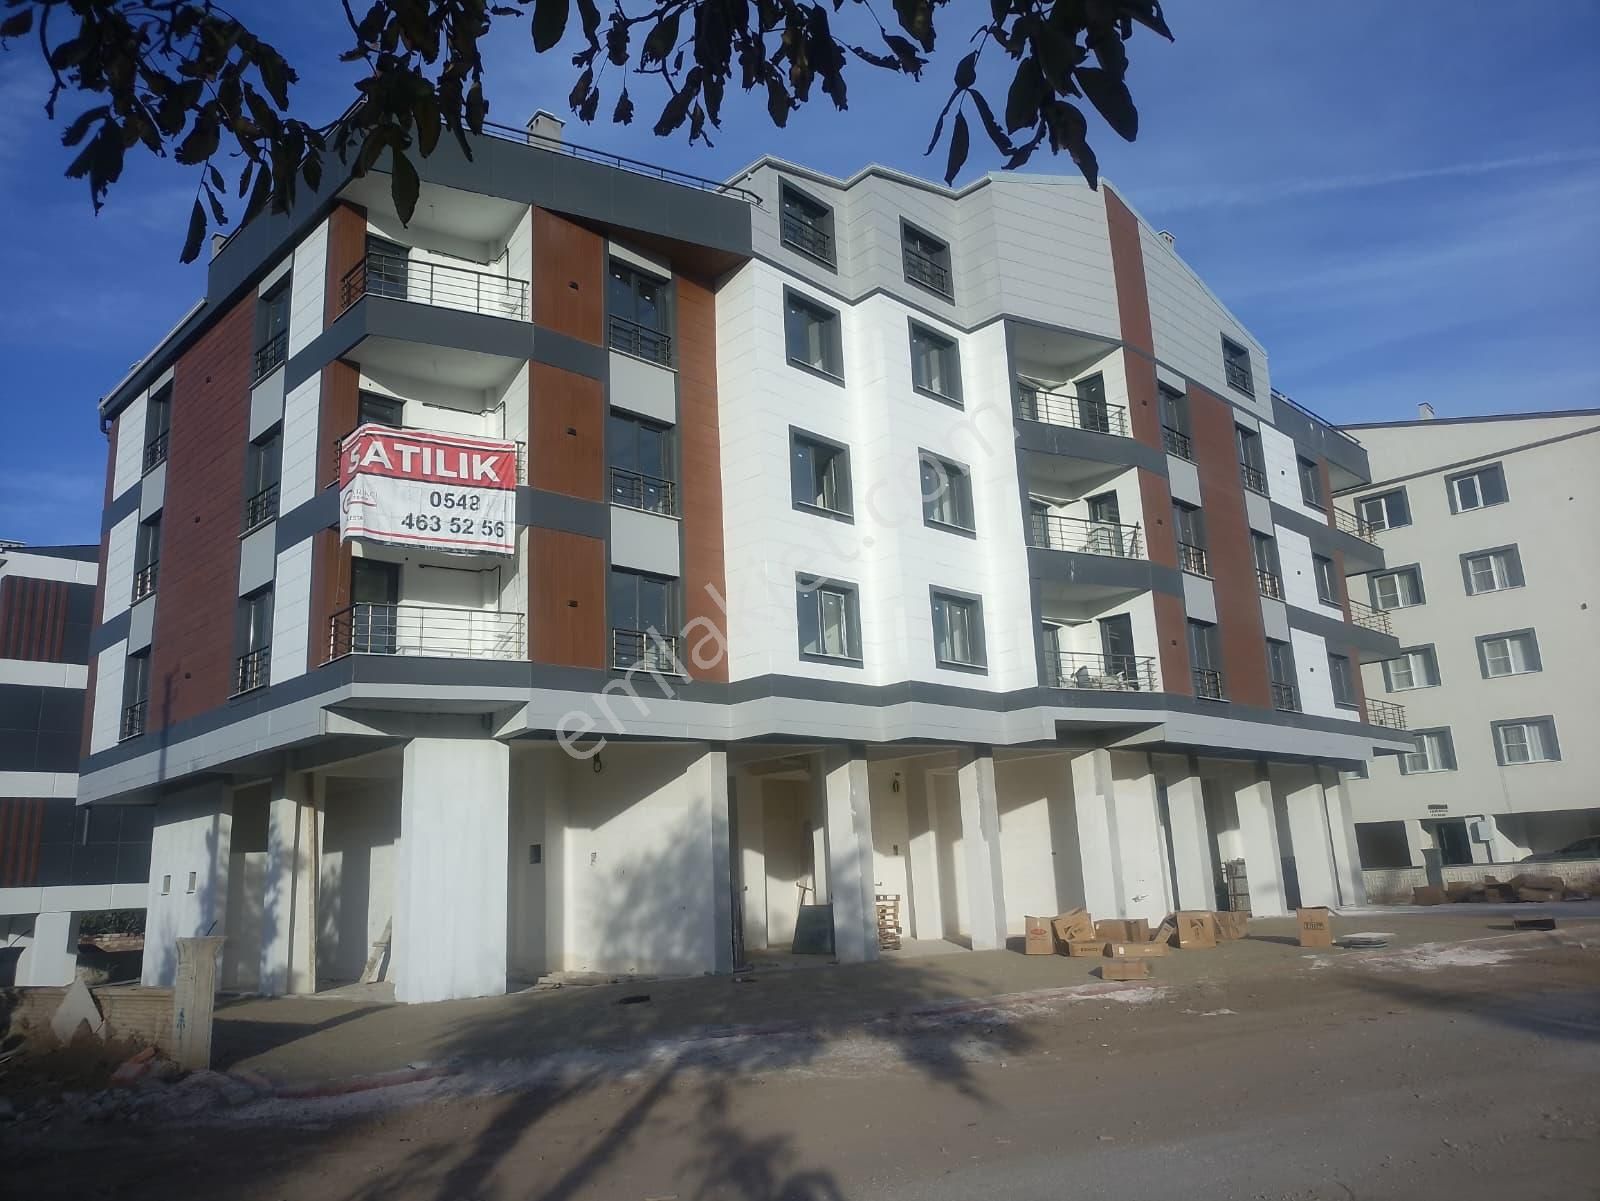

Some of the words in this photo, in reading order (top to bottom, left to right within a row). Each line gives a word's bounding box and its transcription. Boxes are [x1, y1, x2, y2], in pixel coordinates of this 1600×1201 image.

[347, 440, 501, 482] SATILIK
[401, 512, 442, 532] 463
[449, 517, 474, 535] 52
[481, 519, 505, 538] 56
